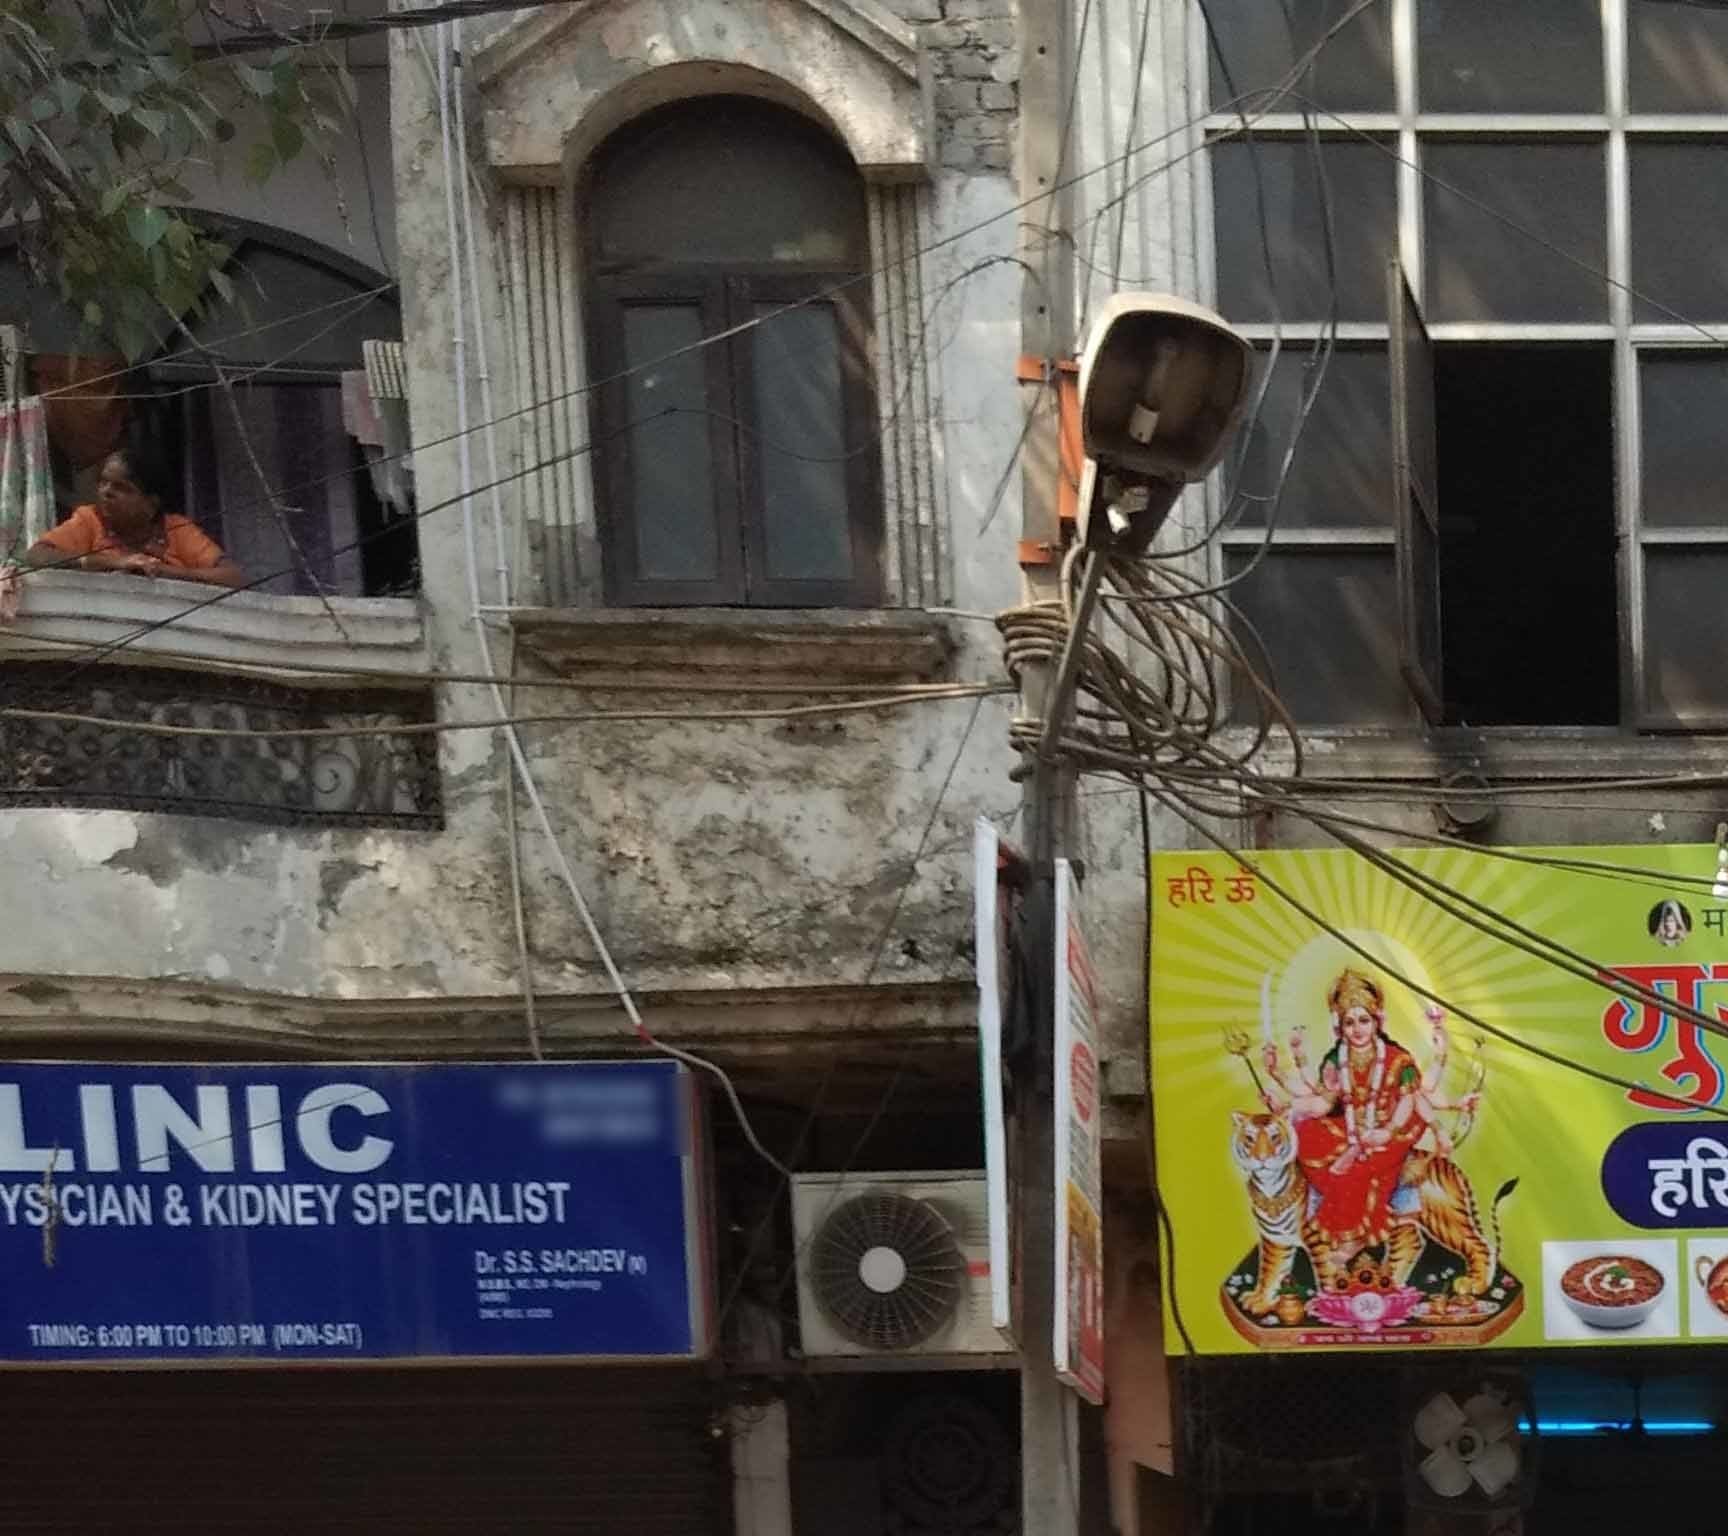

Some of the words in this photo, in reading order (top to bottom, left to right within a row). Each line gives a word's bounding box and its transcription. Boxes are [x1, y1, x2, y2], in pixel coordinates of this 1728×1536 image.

[1167, 865, 1217, 909] हरि
[163, 1184, 192, 1226] &
[201, 1184, 342, 1226] KIDNEY
[352, 1182, 570, 1225] SPECIALIST
[475, 1251, 500, 1274] Dr.
[541, 1249, 625, 1272] SACHDEV
[28, 1324, 96, 1346] TIMING:
[98, 1324, 132, 1346] 6:00
[135, 1324, 164, 1346] PM
[165, 1324, 189, 1345] TO
[192, 1324, 237, 1346] 10:00
[239, 1324, 266, 1346] PM
[273, 1323, 363, 1350] (MON-SAT)
